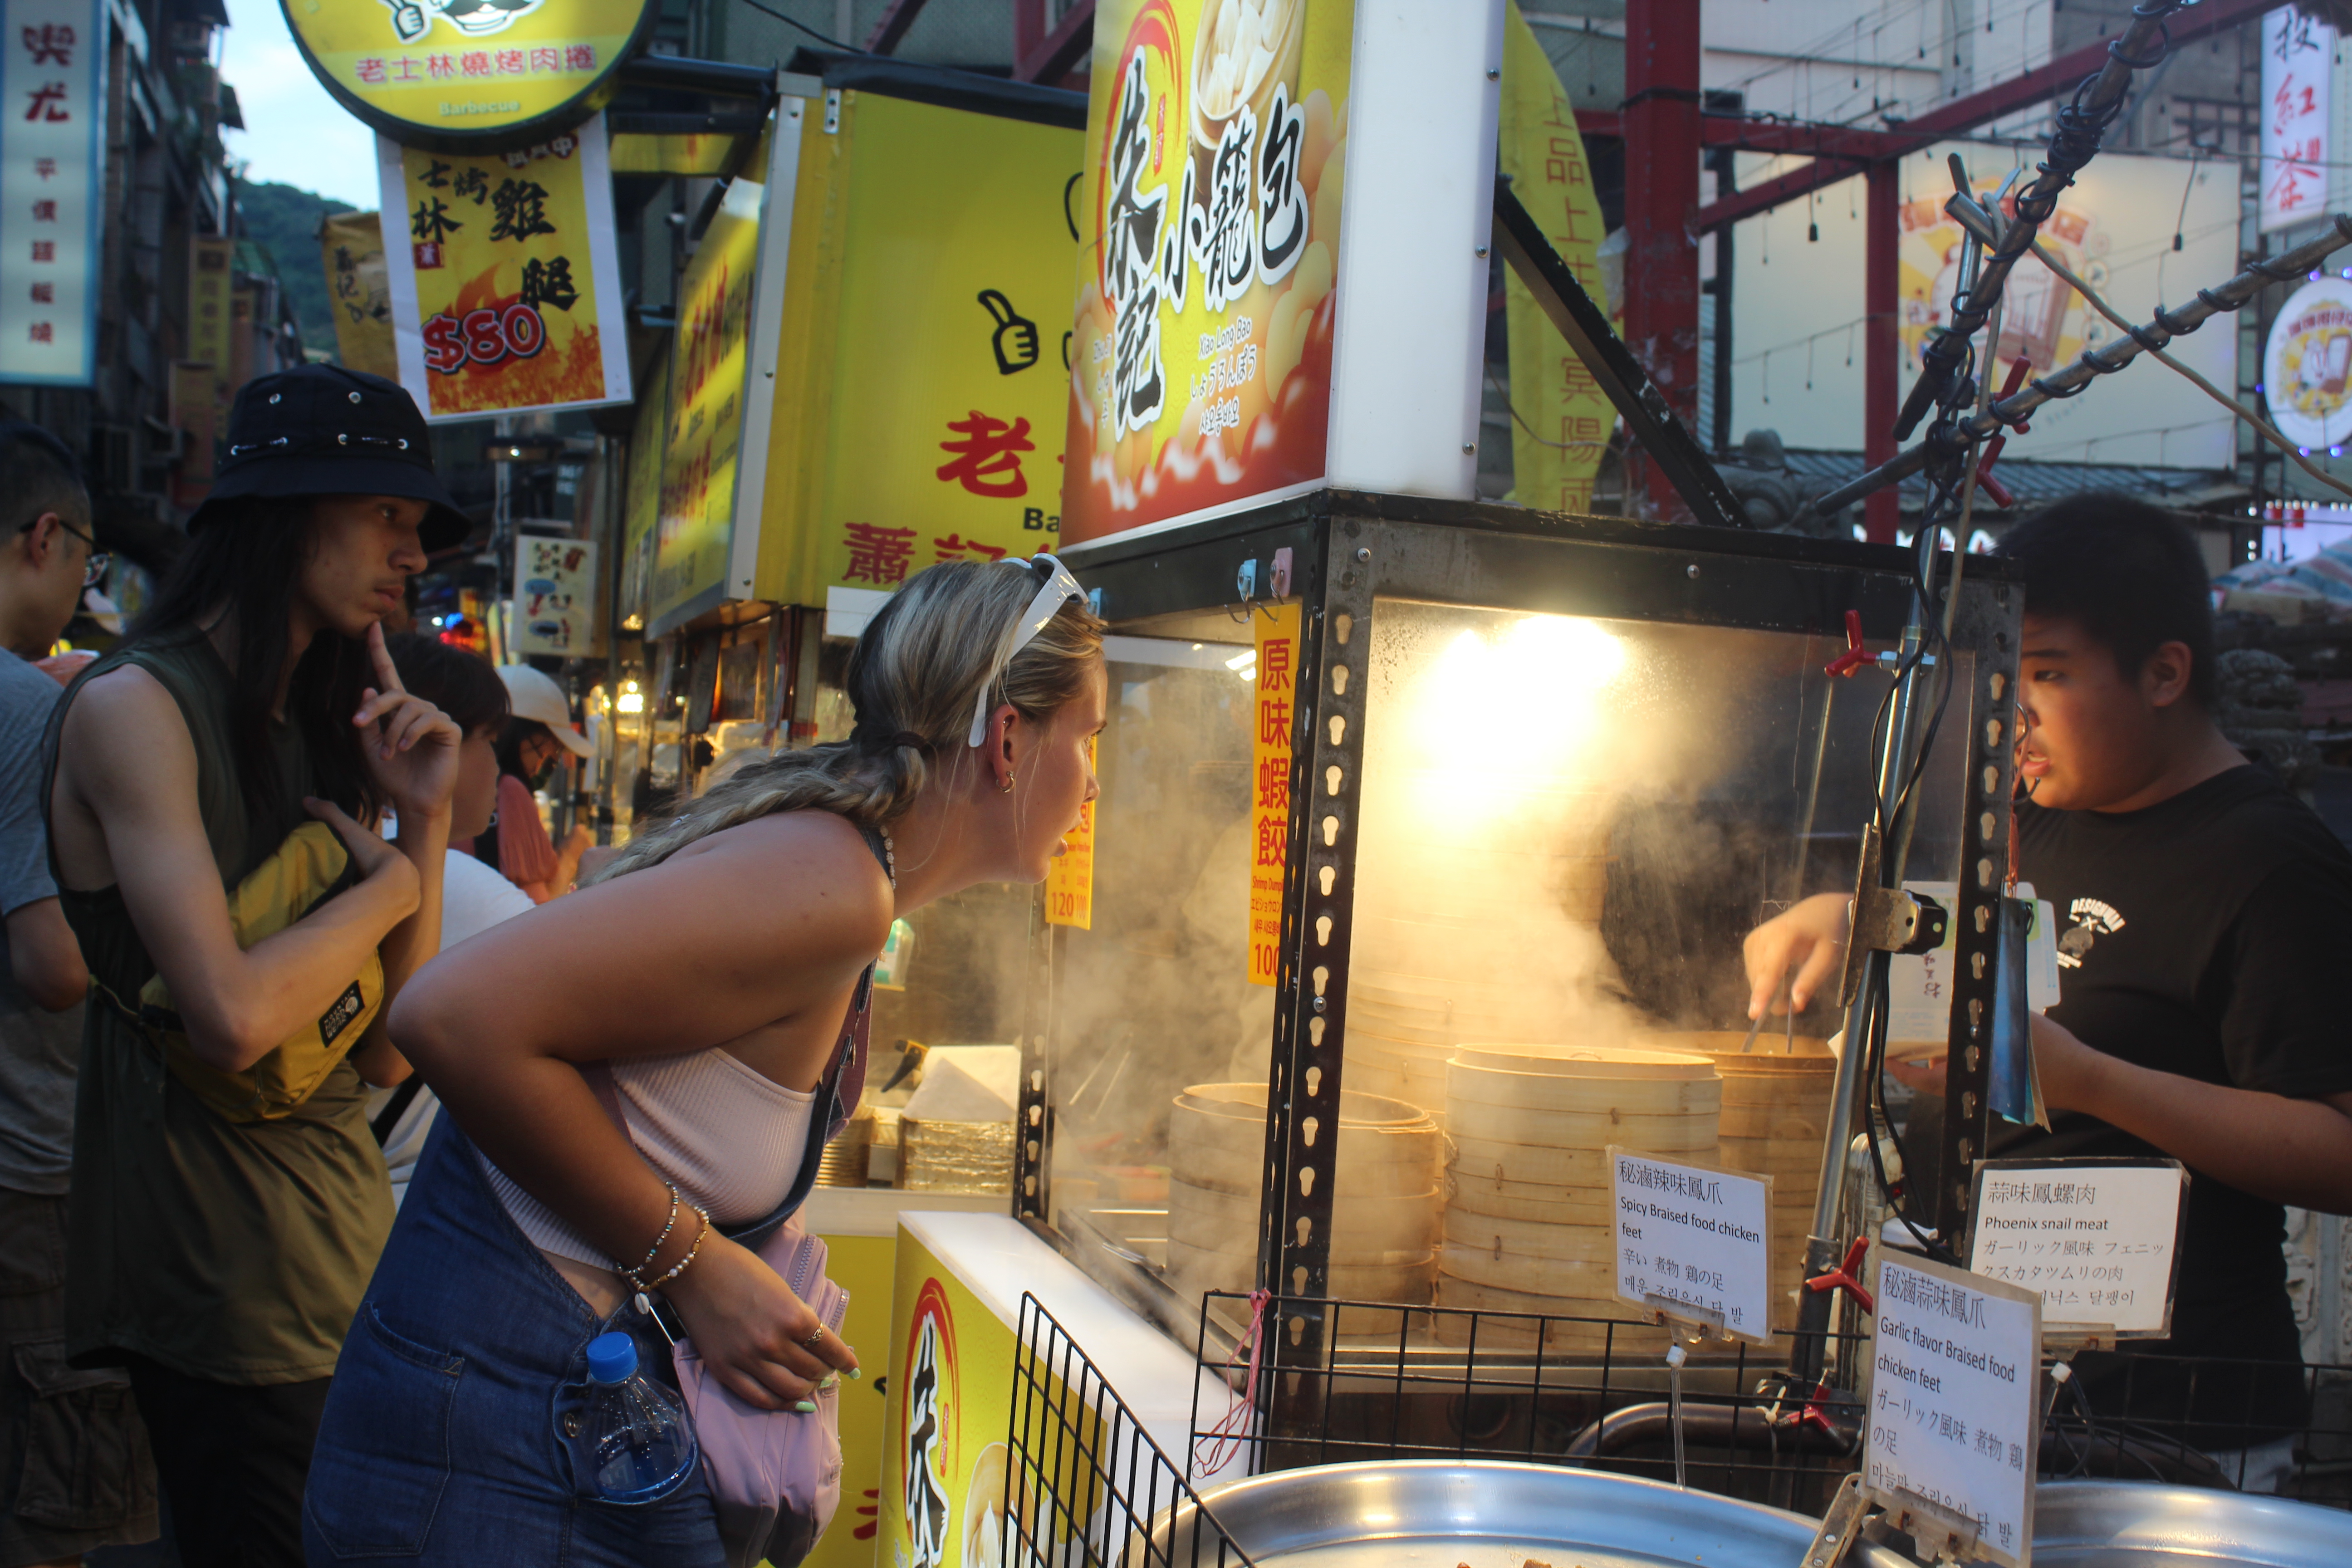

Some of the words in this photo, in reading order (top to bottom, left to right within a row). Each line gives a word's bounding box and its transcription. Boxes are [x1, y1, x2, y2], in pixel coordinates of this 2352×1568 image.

[355, 44, 597, 83] 老士林燒烤肉捲
[439, 101, 520, 116] Barbecue
[1162, 84, 1308, 311] 小籠包
[421, 304, 545, 375] $80
[1199, 334, 1215, 358] Xiao
[1216, 327, 1235, 348] Long
[1237, 317, 1251, 341] Bao
[1191, 346, 1256, 398] しょうろんぽう
[936, 410, 1066, 498] 老
[1258, 639, 1291, 867] 原味蝦餃
[1052, 892, 1074, 916] 120
[1619, 1161, 1723, 1205] 秘滷辣味鳳爪
[1987, 1181, 2097, 1205] 蒜味鳳螺肉
[1621, 1196, 1647, 1217] Spicy
[1651, 1204, 1688, 1225] Braised
[1691, 1213, 1715, 1232] food
[1719, 1222, 1759, 1244] chicken
[1622, 1222, 1642, 1240] feet
[1984, 1216, 2038, 1230] Phoenix
[2041, 1217, 2072, 1230] snail
[2075, 1219, 2109, 1231] meat
[1983, 1240, 2095, 1257] ガーリック風味
[2104, 1240, 2164, 1256] フェニッ
[1622, 1248, 1647, 1266] 辛い
[1654, 1255, 1679, 1279] 煮物
[1685, 1264, 1724, 1292] 鶏の足
[1625, 1274, 1648, 1296] 매운
[1731, 1306, 1743, 1325] 발
[1883, 1265, 1986, 1330] 秘滷蒜味鳳爪
[2089, 1289, 2134, 1306] 달팽이
[1881, 1317, 1911, 1343] Garlic
[1913, 1325, 1944, 1356] flavor
[1946, 1338, 1986, 1372] Braised
[1989, 1354, 2015, 1383] food
[1877, 1353, 1916, 1383] chicken
[1919, 1367, 1941, 1394] feet
[1873, 1426, 1897, 1457] の足
[1876, 1388, 1967, 1446] ガーリック風味
[1974, 1427, 2003, 1462] 煮物
[2009, 1442, 2023, 1472] 鶏
[1999, 1522, 2013, 1549] 발
